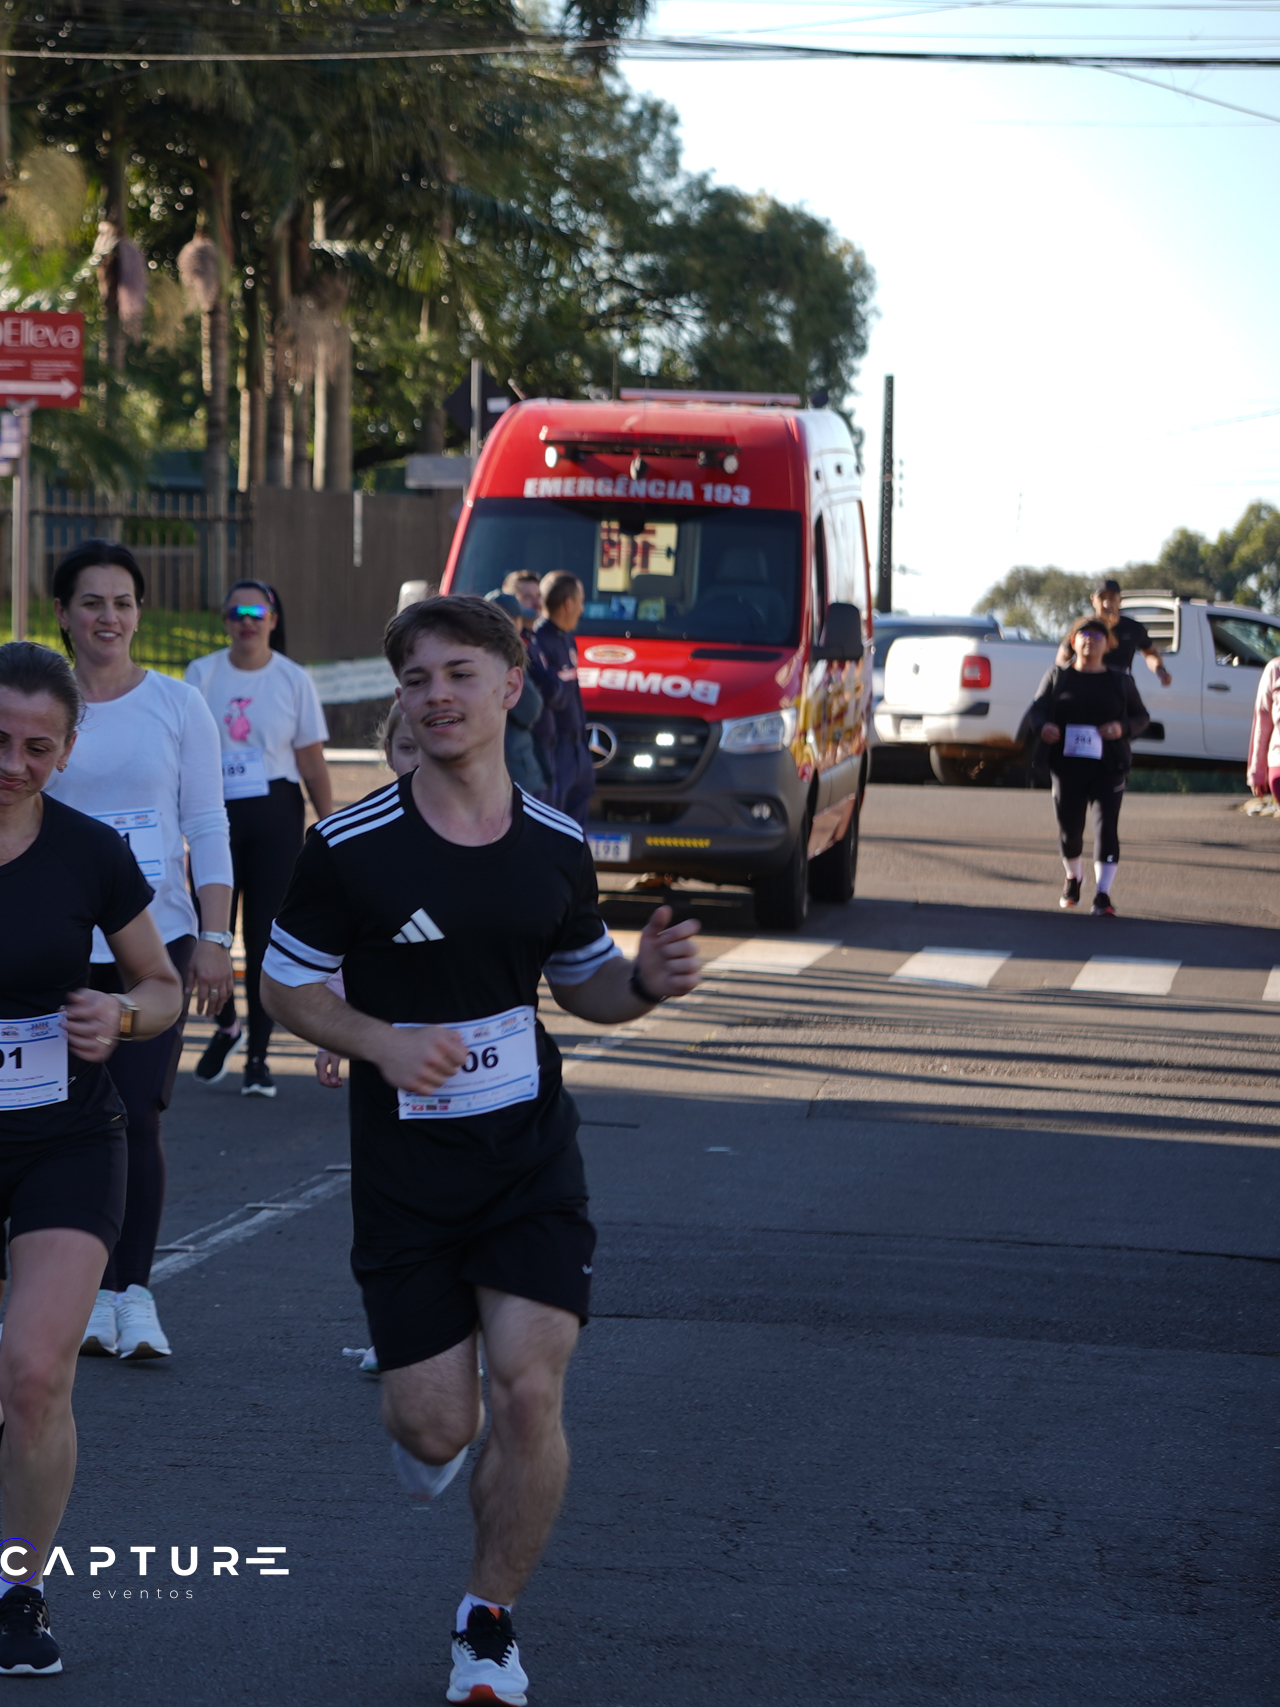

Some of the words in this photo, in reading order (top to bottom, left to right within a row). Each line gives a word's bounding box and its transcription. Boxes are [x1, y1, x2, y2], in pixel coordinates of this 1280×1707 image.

[3, 316, 80, 349] Elleva
[523, 474, 694, 500] EMERGÊNCIA
[700, 482, 750, 506] 193
[461, 1046, 499, 1073] 06
